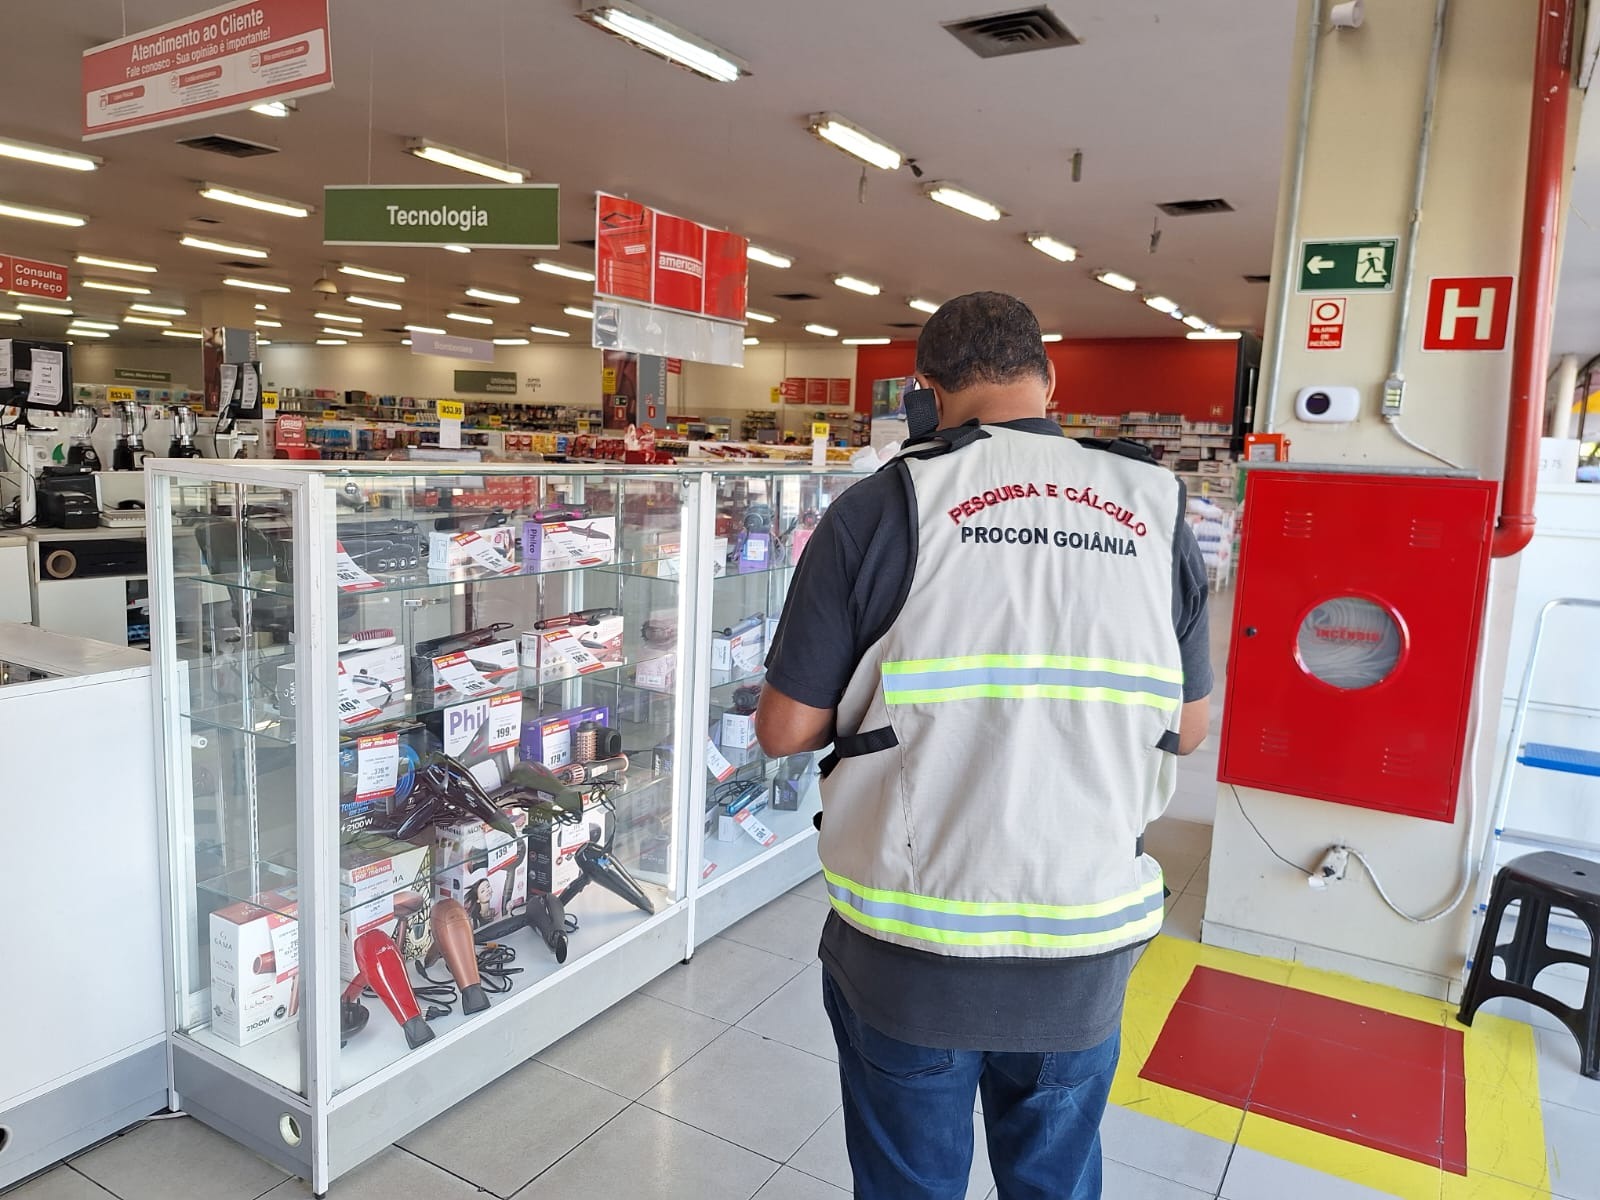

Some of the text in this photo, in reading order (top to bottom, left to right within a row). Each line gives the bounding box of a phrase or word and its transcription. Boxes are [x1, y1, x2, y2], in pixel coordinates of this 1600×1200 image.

[131, 7, 264, 63] Atendimento ao Cliente
[126, 65, 141, 79] Fale
[141, 58, 170, 75] conosco
[175, 52, 190, 65] Sua
[190, 44, 219, 63] opinião
[219, 38, 225, 51] é
[226, 26, 271, 52] importante!
[386, 205, 488, 231] Tecnologia
[15, 264, 62, 280] Consulta
[16, 277, 63, 293] de Preço
[1439, 287, 1496, 340] H
[948, 483, 1147, 537] PESQUISA E CÁLCULO
[529, 529, 538, 553] Philco
[961, 526, 1137, 557] PROCON GOIÂNIA
[1315, 626, 1380, 643] INCÊNDIO
[449, 705, 487, 736] Phil
[374, 738, 397, 746] menos
[355, 865, 391, 880] por menos
[246, 1017, 271, 1032] 2100W
